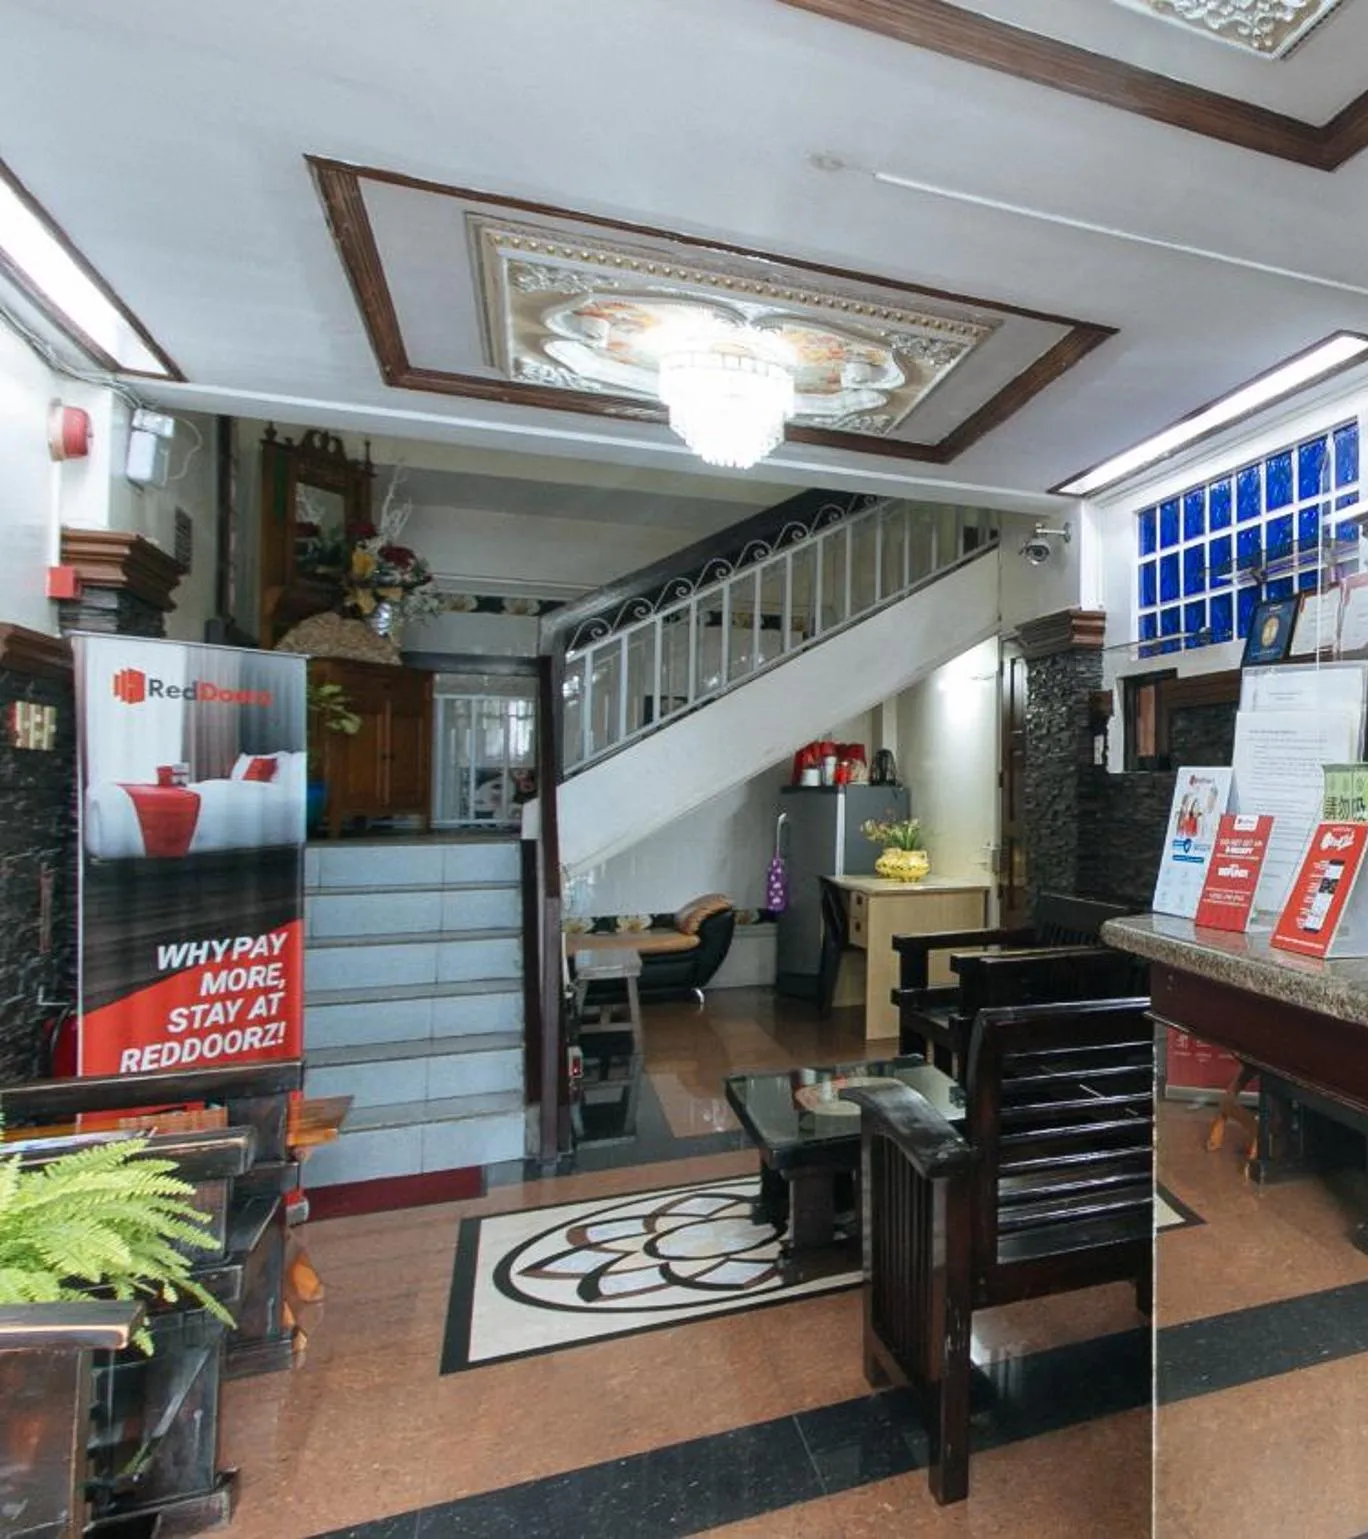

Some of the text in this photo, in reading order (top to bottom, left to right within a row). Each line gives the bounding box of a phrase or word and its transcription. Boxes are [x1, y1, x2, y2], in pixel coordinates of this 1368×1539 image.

[157, 932, 288, 971] WHY PAY
[200, 963, 287, 996] MORE,
[167, 992, 285, 1033] STAY AT
[119, 1021, 287, 1074] REDDOORZ!
